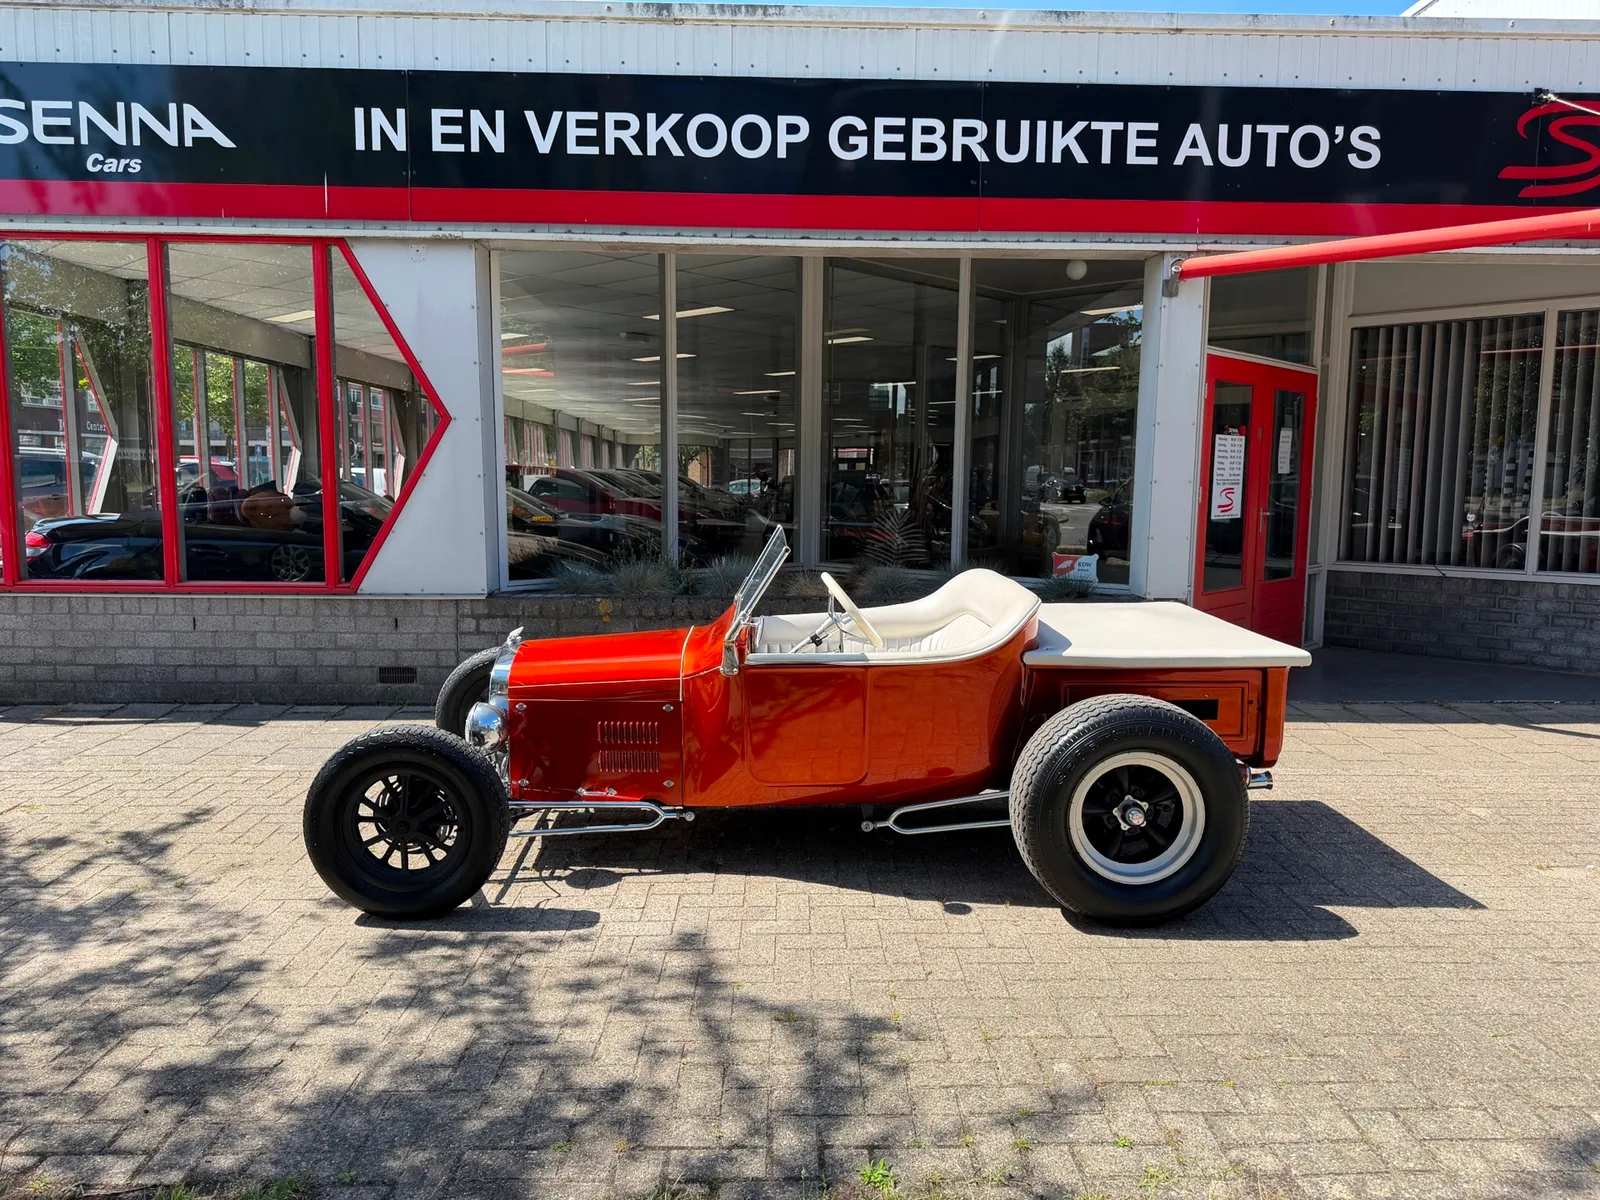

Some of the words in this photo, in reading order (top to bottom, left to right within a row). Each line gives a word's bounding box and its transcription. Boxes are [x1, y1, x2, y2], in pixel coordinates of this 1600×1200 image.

[0, 98, 237, 148] SENNA
[355, 108, 407, 155] IN
[432, 109, 505, 155] EN
[524, 111, 810, 160] VERKOOP
[829, 116, 1159, 166] GEBRUIKTE
[1173, 123, 1381, 170] AUTO'S
[86, 152, 142, 175] Cars
